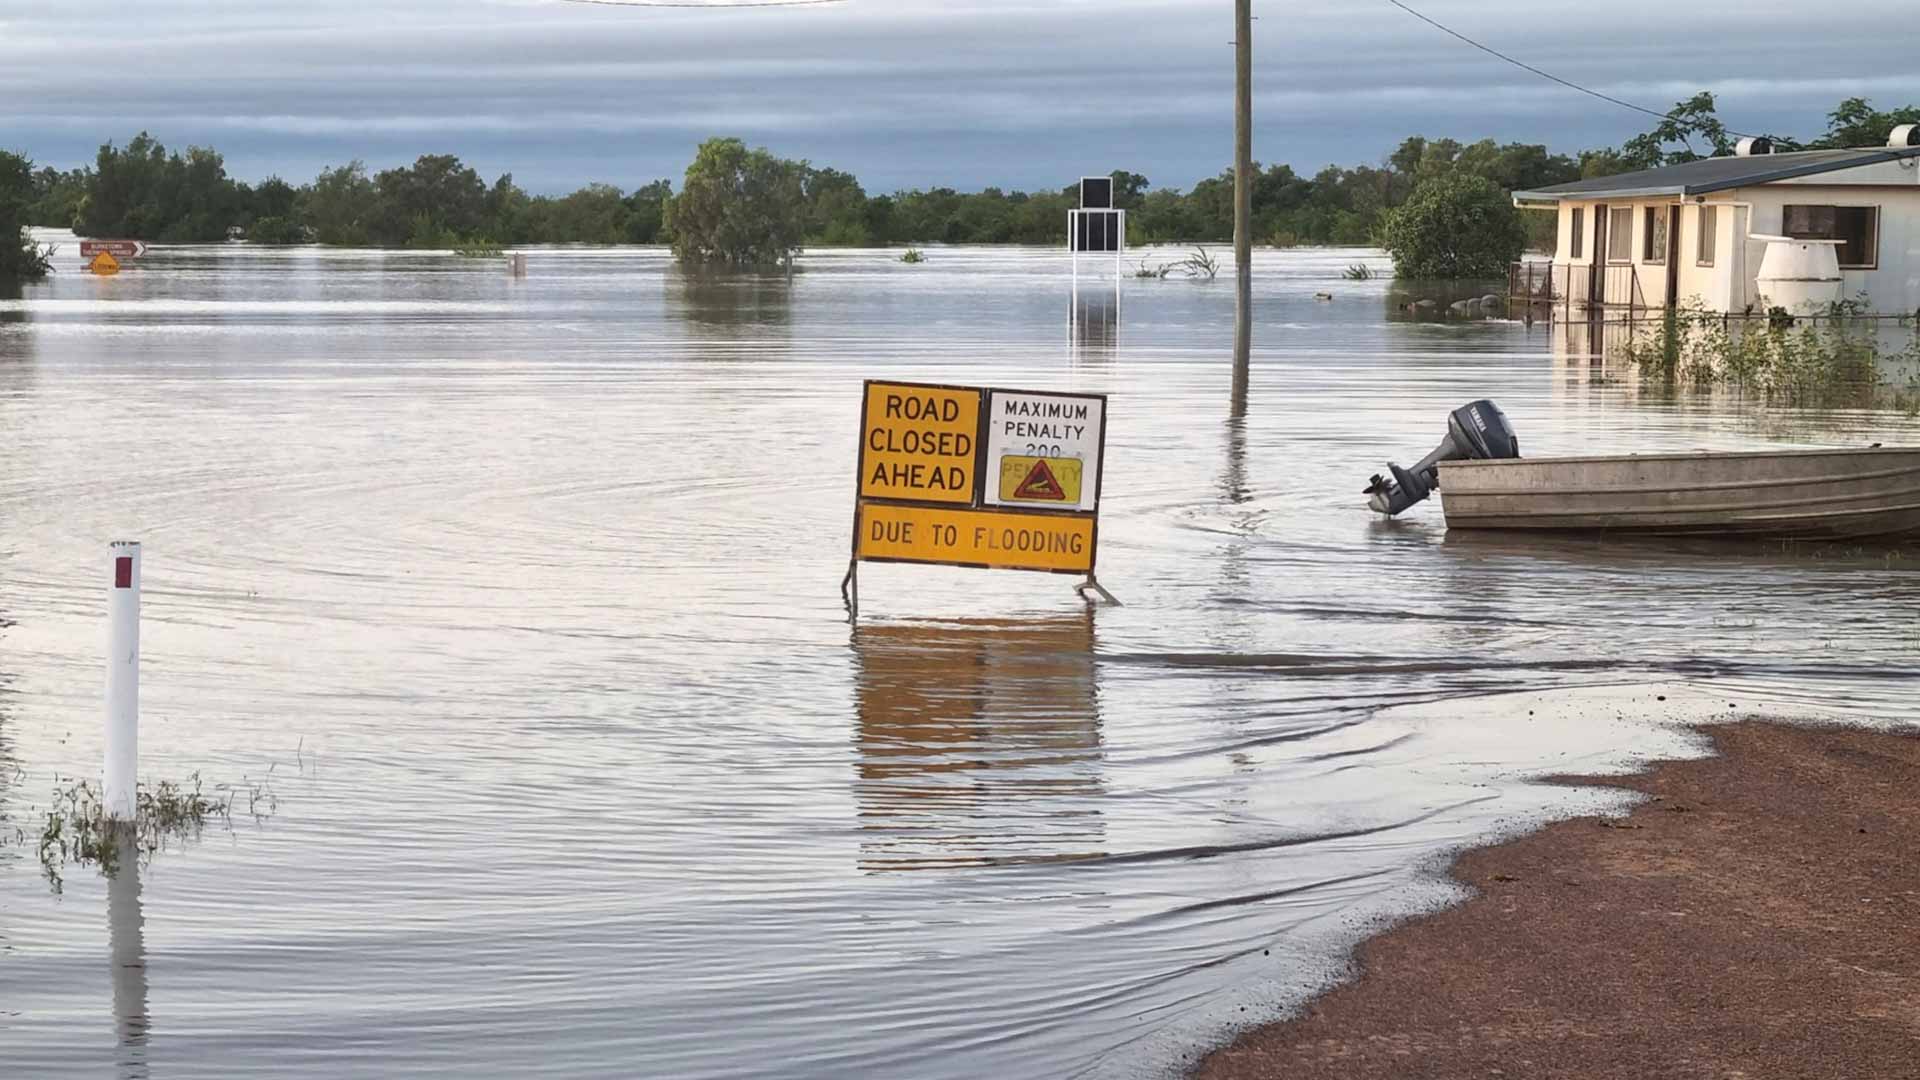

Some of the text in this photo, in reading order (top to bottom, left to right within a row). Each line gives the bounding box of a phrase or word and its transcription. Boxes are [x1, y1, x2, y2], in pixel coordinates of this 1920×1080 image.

[886, 394, 959, 422] ROAD
[1005, 400, 1087, 420] MAXIMUM
[870, 427, 971, 457] CLOSED
[1005, 421, 1085, 440] PENALTY
[1026, 443, 1061, 458] 200
[871, 462, 965, 490] AHEAD
[871, 520, 1083, 555] DUE TO FLOODING
